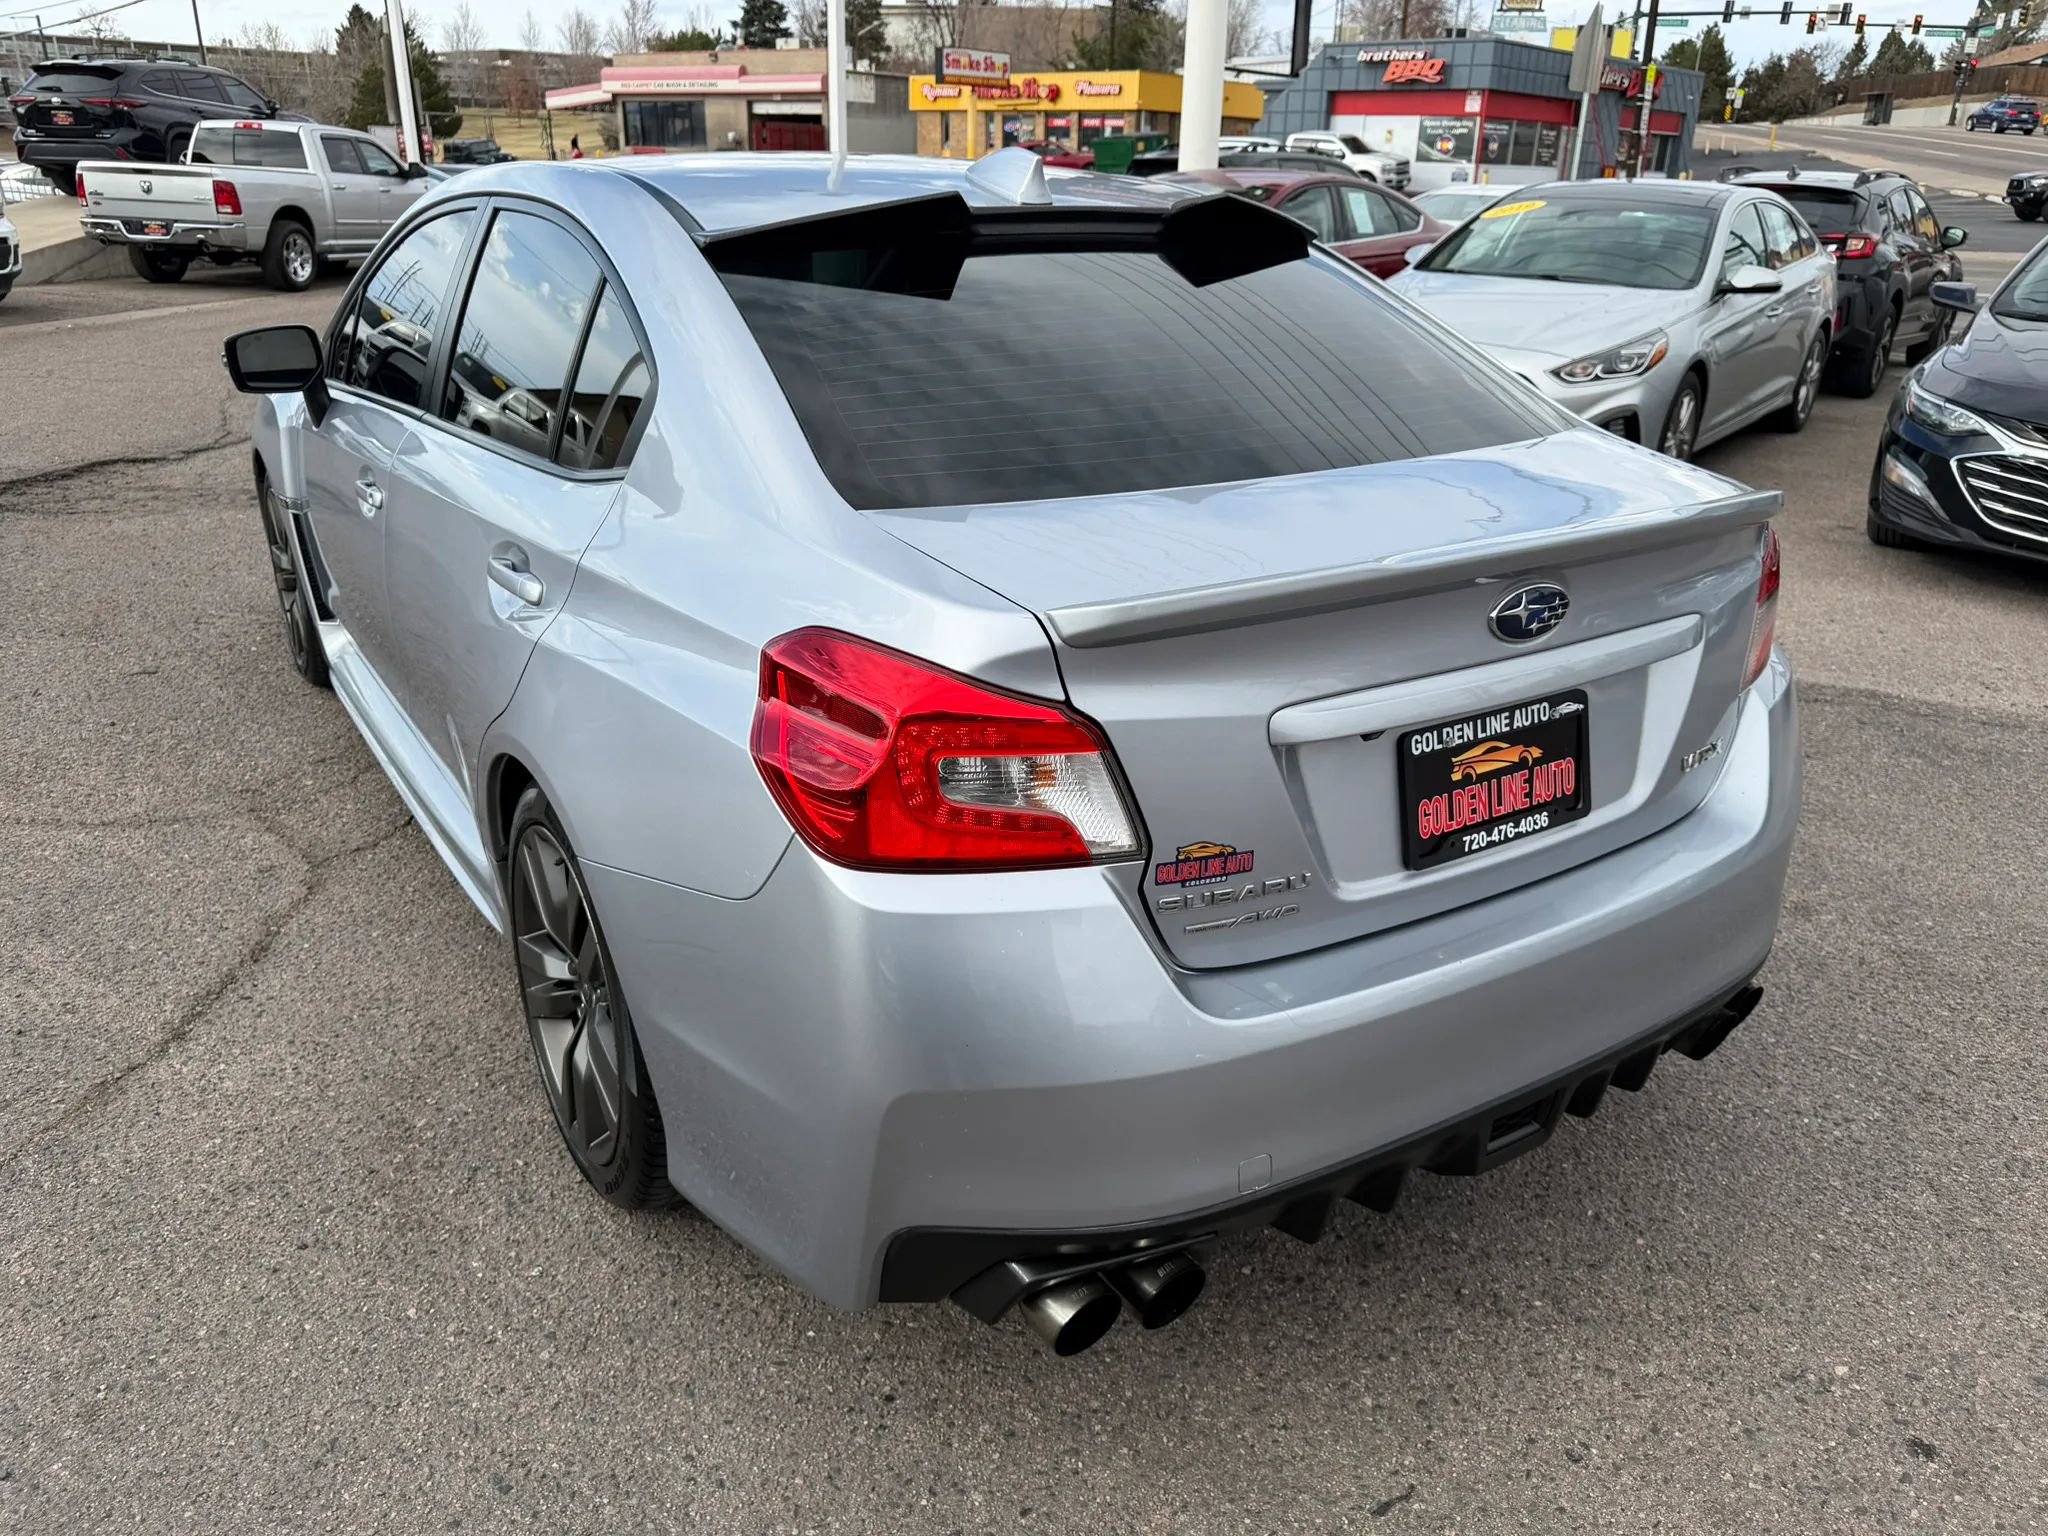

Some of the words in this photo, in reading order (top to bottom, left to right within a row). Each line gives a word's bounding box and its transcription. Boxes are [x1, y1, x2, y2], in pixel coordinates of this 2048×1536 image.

[945, 51, 981, 71] Smoke
[1383, 59, 1446, 84] BBQ
[1411, 721, 1474, 755] GOLDEN
[1477, 712, 1510, 739] LINE
[1513, 702, 1550, 729] AUTO
[1418, 782, 1489, 840] GOLDEN
[1491, 771, 1530, 817] LINE
[1532, 757, 1575, 805] AUTO
[1462, 811, 1549, 852] 720-476-4036
[1157, 860, 1200, 883] GOLDEN
[1201, 856, 1225, 878] LINE
[1226, 852, 1253, 873] AUTO
[1185, 876, 1228, 887] COLORADO
[1157, 871, 1313, 914] SUBARU
